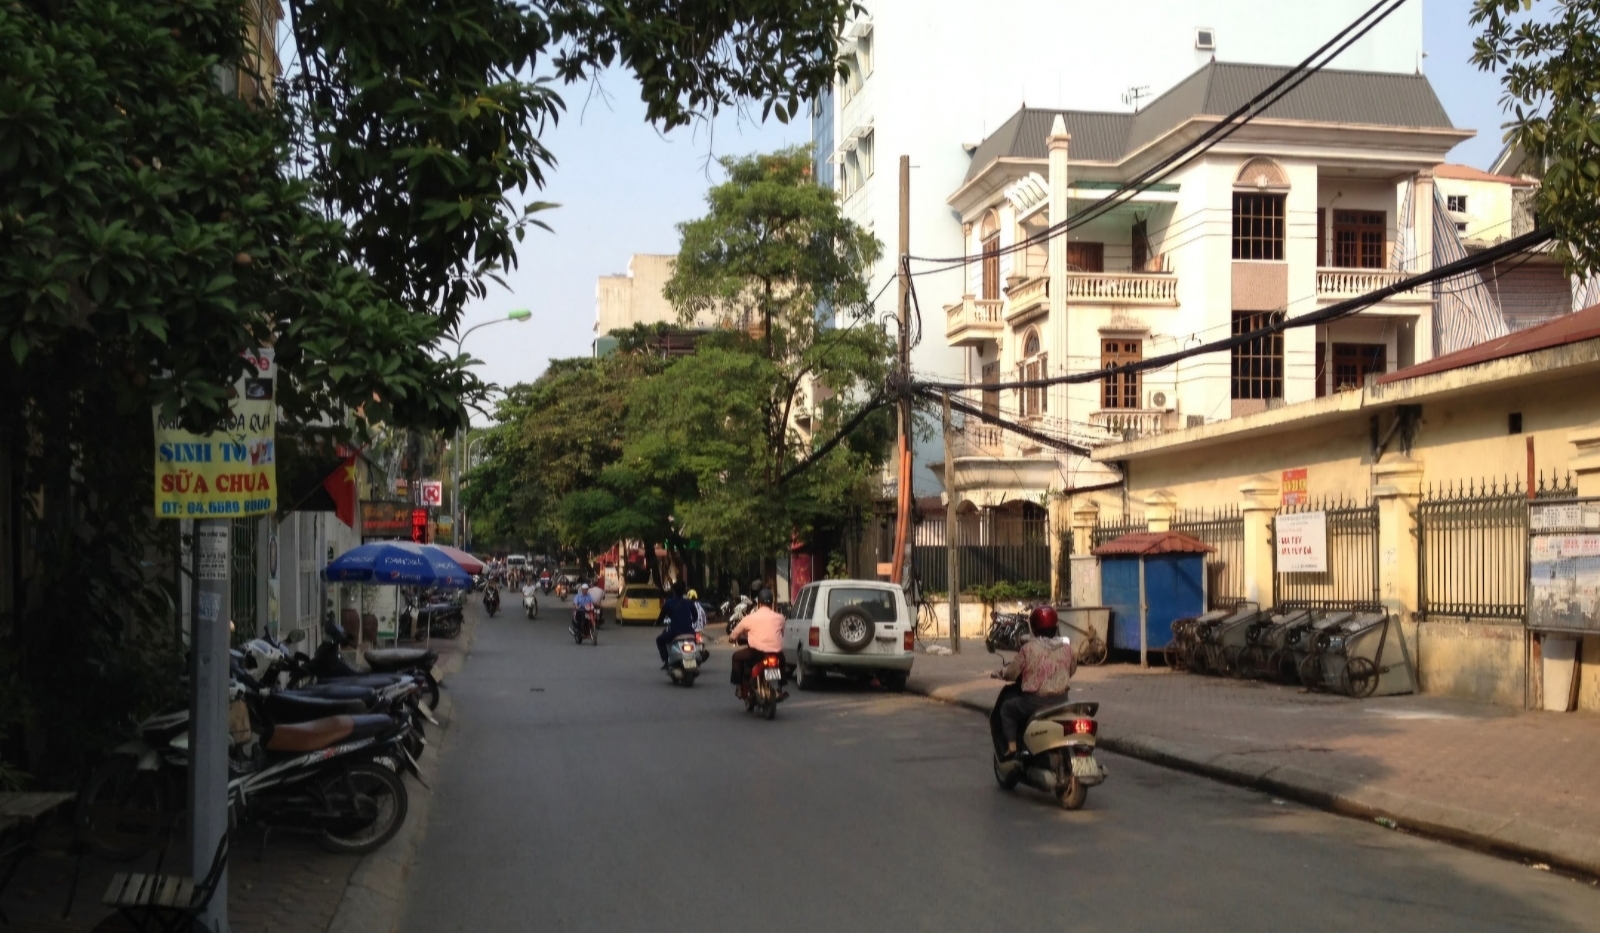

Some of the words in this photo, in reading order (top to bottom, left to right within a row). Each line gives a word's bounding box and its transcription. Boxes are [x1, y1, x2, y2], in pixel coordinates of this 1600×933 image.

[159, 440, 212, 462] SINH
[161, 469, 209, 494] SỮA
[215, 471, 270, 493] CHUA
